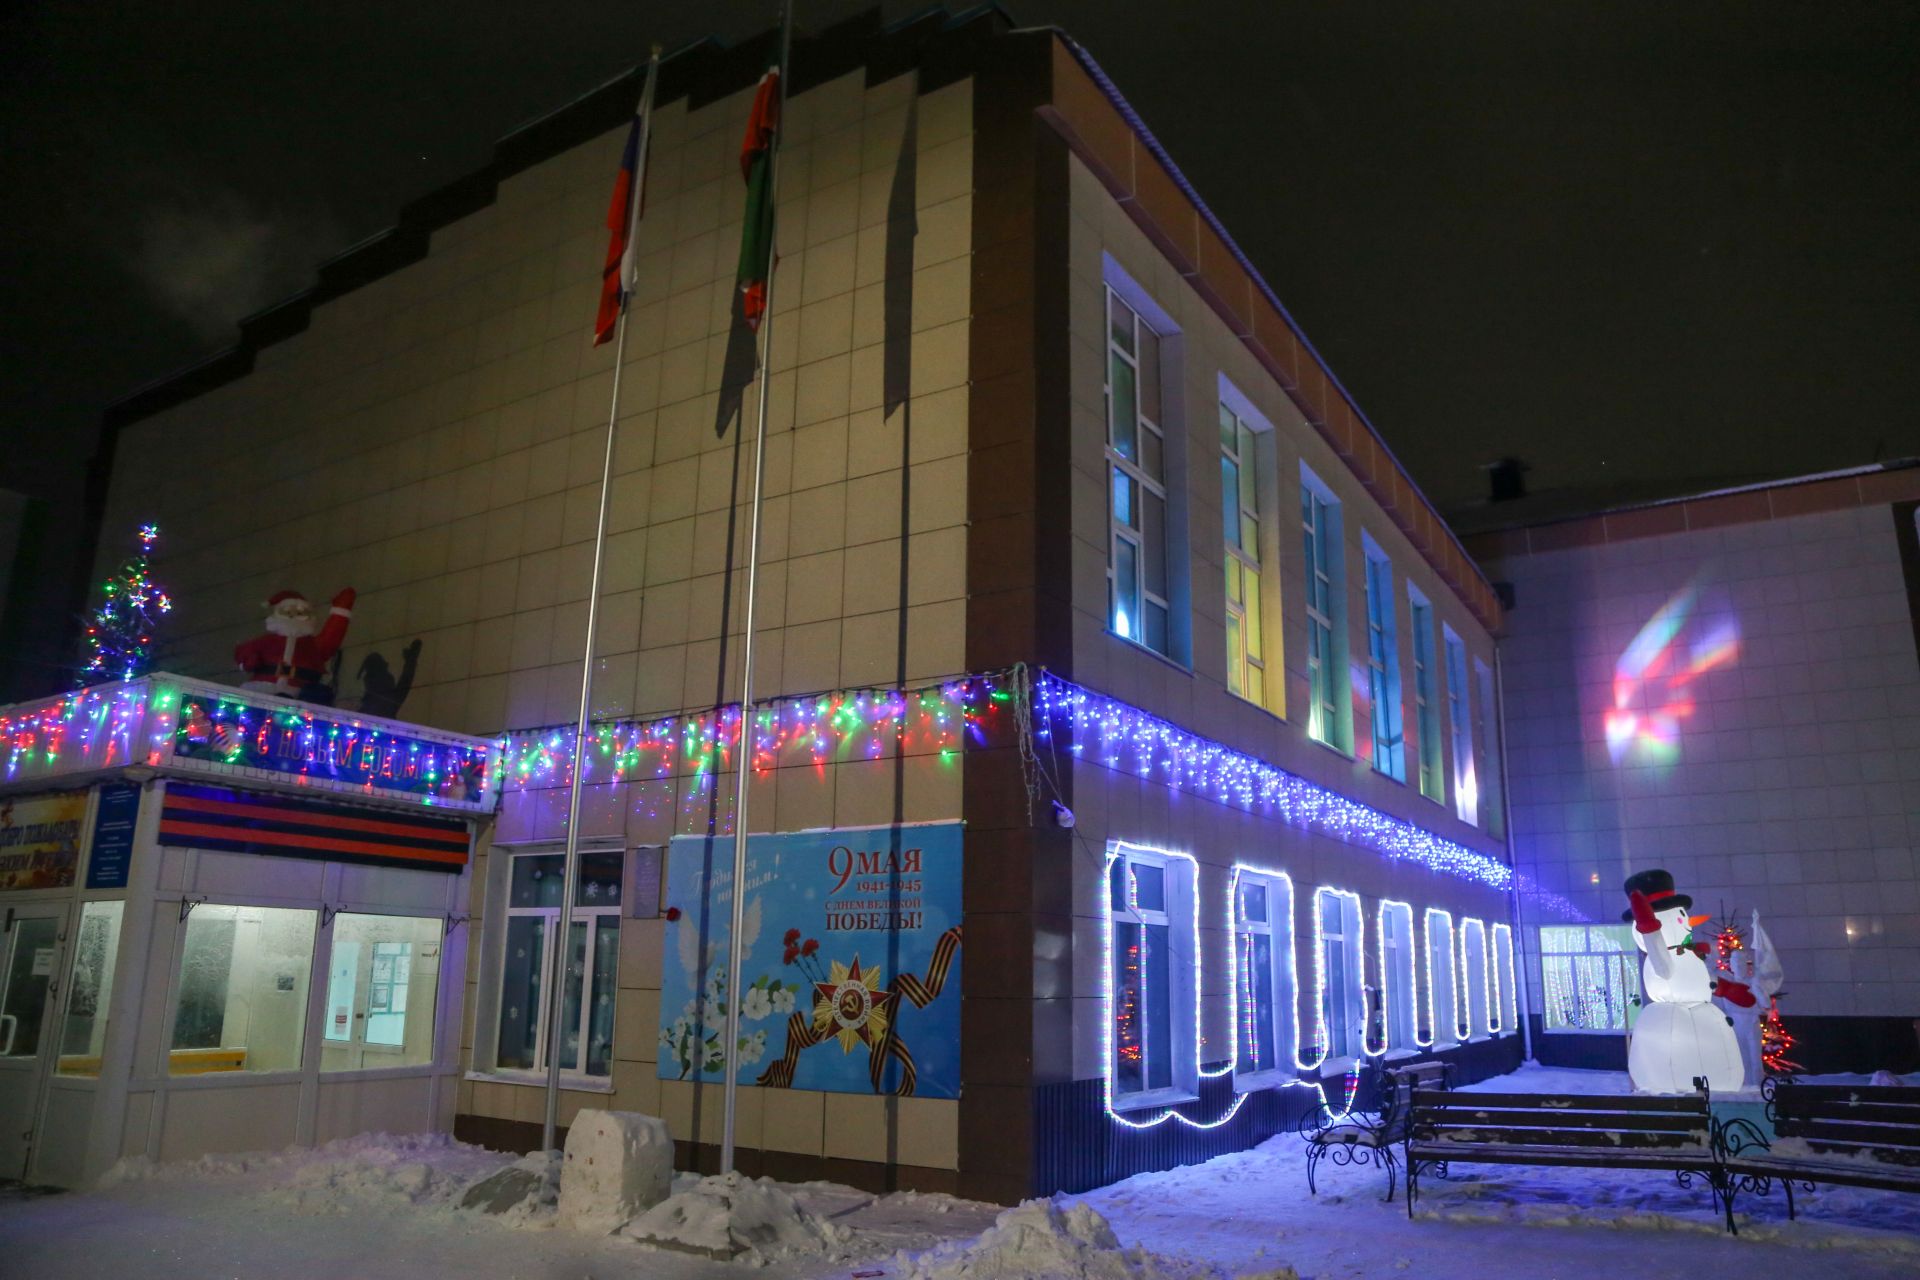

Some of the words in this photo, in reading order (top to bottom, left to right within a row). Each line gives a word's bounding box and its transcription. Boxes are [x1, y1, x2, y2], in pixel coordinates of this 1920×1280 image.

[828, 846, 854, 896] 9
[856, 848, 922, 875] МАЯ
[856, 880, 921, 894] 1941-1945
[867, 896, 921, 910] ВЕЛИКОЙ
[825, 911, 923, 932] ПОБЕДЫ!
